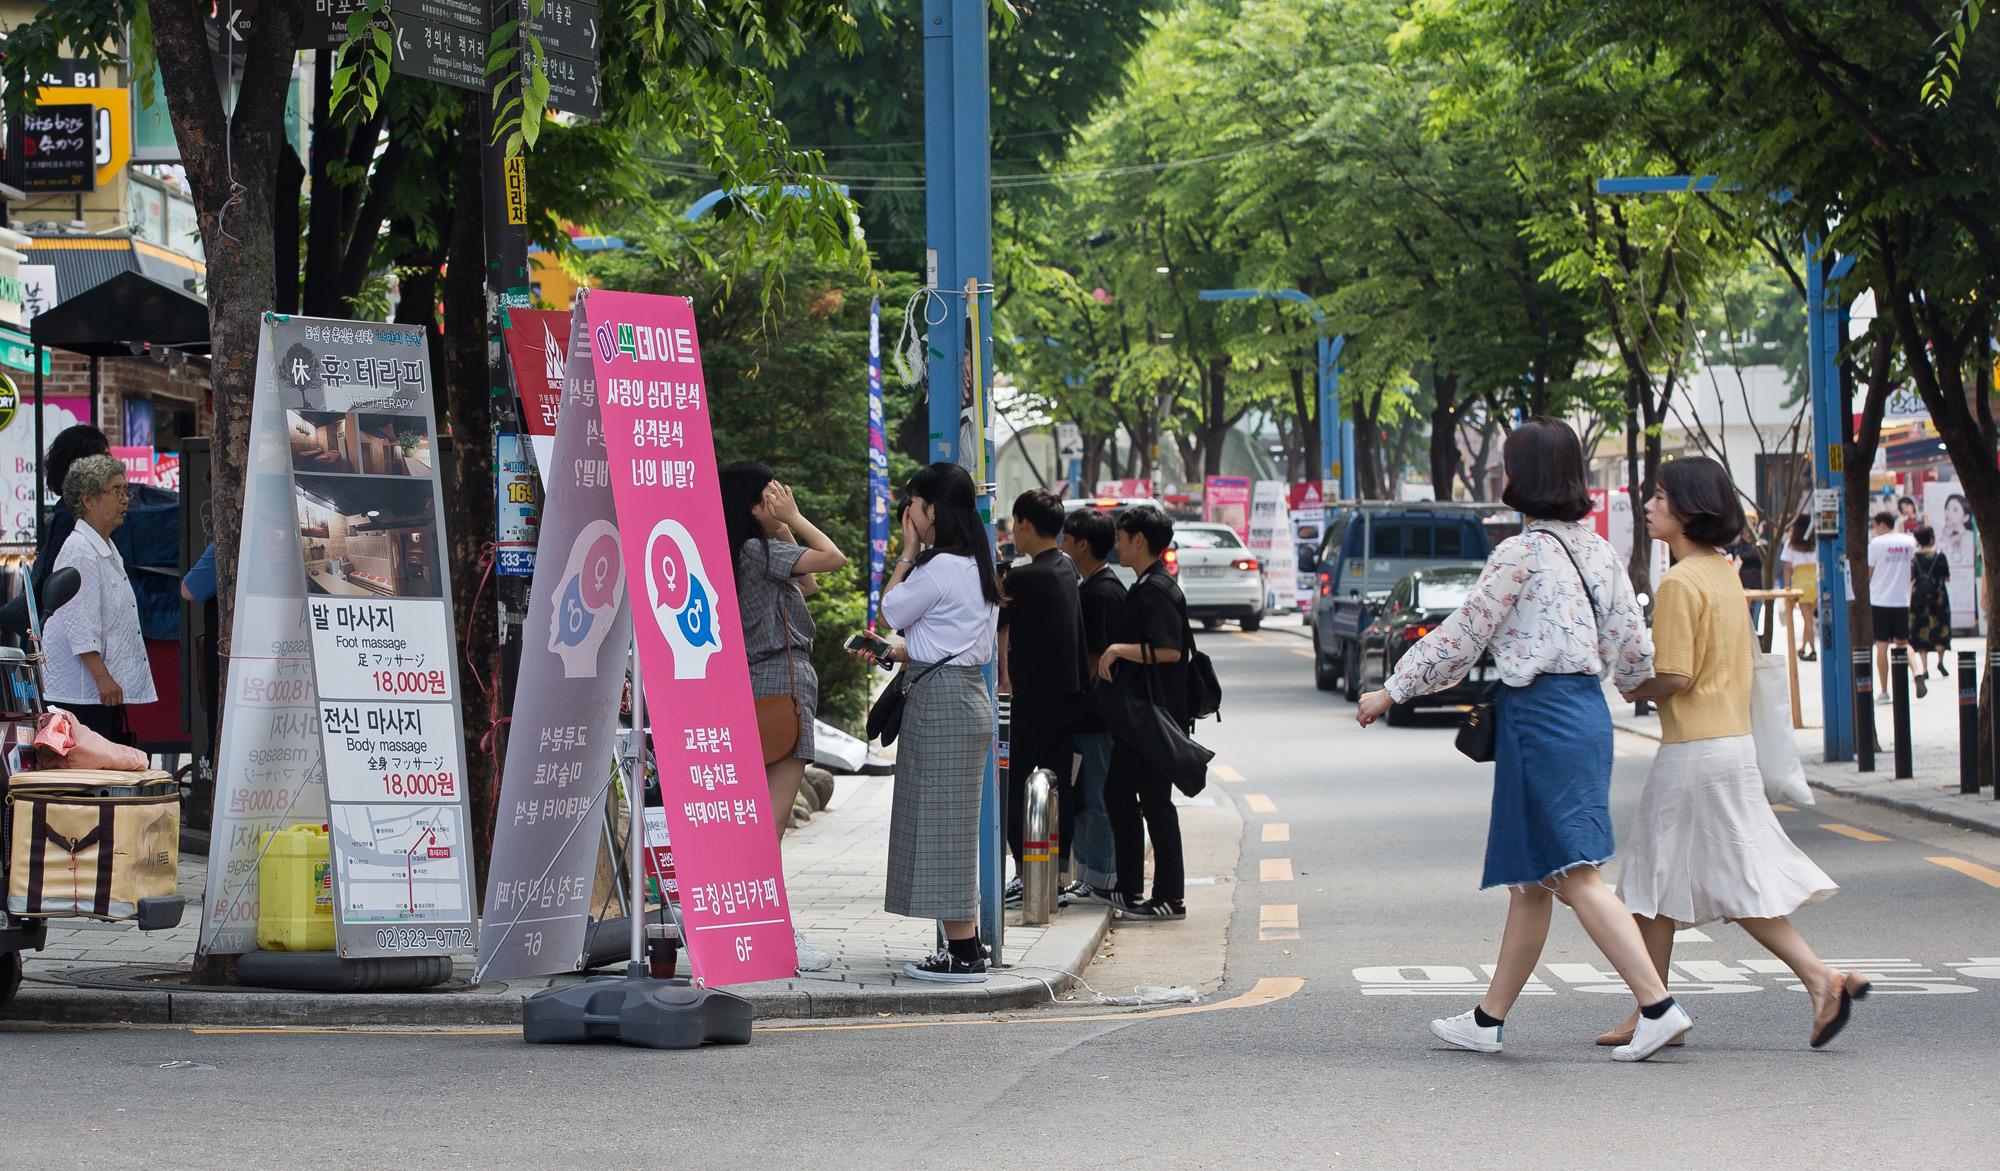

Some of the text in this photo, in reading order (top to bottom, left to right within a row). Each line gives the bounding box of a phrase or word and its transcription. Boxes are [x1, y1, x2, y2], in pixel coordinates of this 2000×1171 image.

[316, 0, 391, 17] 마포
[468, 2, 482, 14] Center
[238, 20, 251, 29] 120
[331, 22, 348, 32] Map
[424, 27, 485, 61] 경의선 책거리
[433, 54, 486, 75] Gyeongui Line Book Street
[74, 72, 96, 88] B1
[564, 85, 576, 97] Center
[71, 174, 84, 185] 2F
[508, 158, 523, 222] 사다리차
[305, 325, 320, 341] 도심
[321, 326, 331, 344] 속
[332, 326, 354, 345] 휴식을
[355, 328, 373, 345] 위한
[595, 320, 695, 364] 이색데이트
[291, 357, 311, 386] 休
[346, 395, 415, 410] HUE THERAPY
[606, 378, 700, 411] 사랑의 심리 분석
[632, 418, 684, 449] 성격분석
[631, 458, 695, 489] 너의 비밀?
[312, 603, 395, 632] 발 마사지
[336, 635, 406, 651] Foot massage
[357, 652, 425, 668] 足 マッサージ
[372, 670, 446, 695] 18,000원
[323, 707, 422, 736] 전신 마사지
[346, 737, 428, 754] Body massage
[684, 727, 733, 753] 교류분석
[367, 755, 444, 771] 全身 マッサージ
[382, 772, 455, 798] 18,000원
[689, 763, 738, 792] 미술치료
[683, 798, 759, 828] 빅데이터 분석
[691, 877, 780, 916] 코칭심리카페
[376, 926, 473, 951] 02)323-9772
[735, 935, 753, 963] 6F
